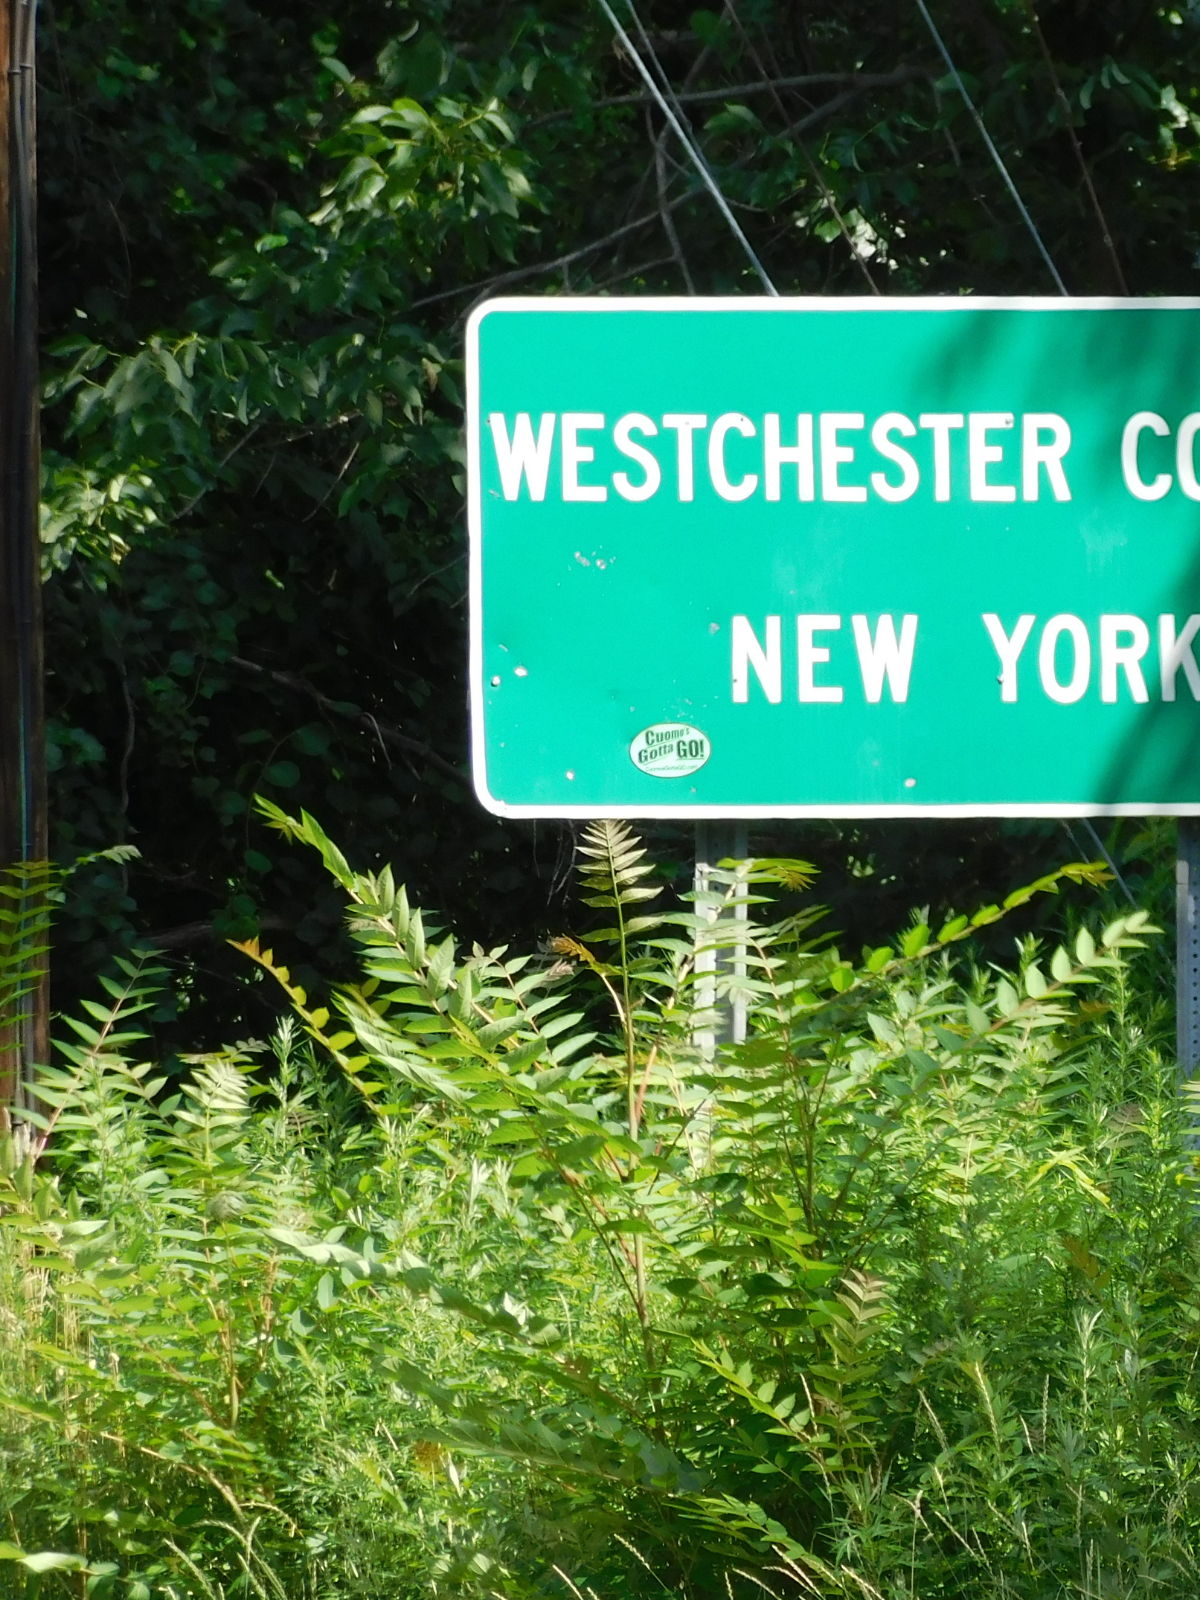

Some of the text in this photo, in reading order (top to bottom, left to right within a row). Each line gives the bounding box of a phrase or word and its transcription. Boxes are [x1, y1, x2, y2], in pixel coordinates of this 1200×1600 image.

[487, 411, 1073, 502] WESTCHESTER
[731, 613, 918, 704] NEW
[638, 739, 704, 764] Gotta GO!
[645, 727, 690, 746] Cuomo's
